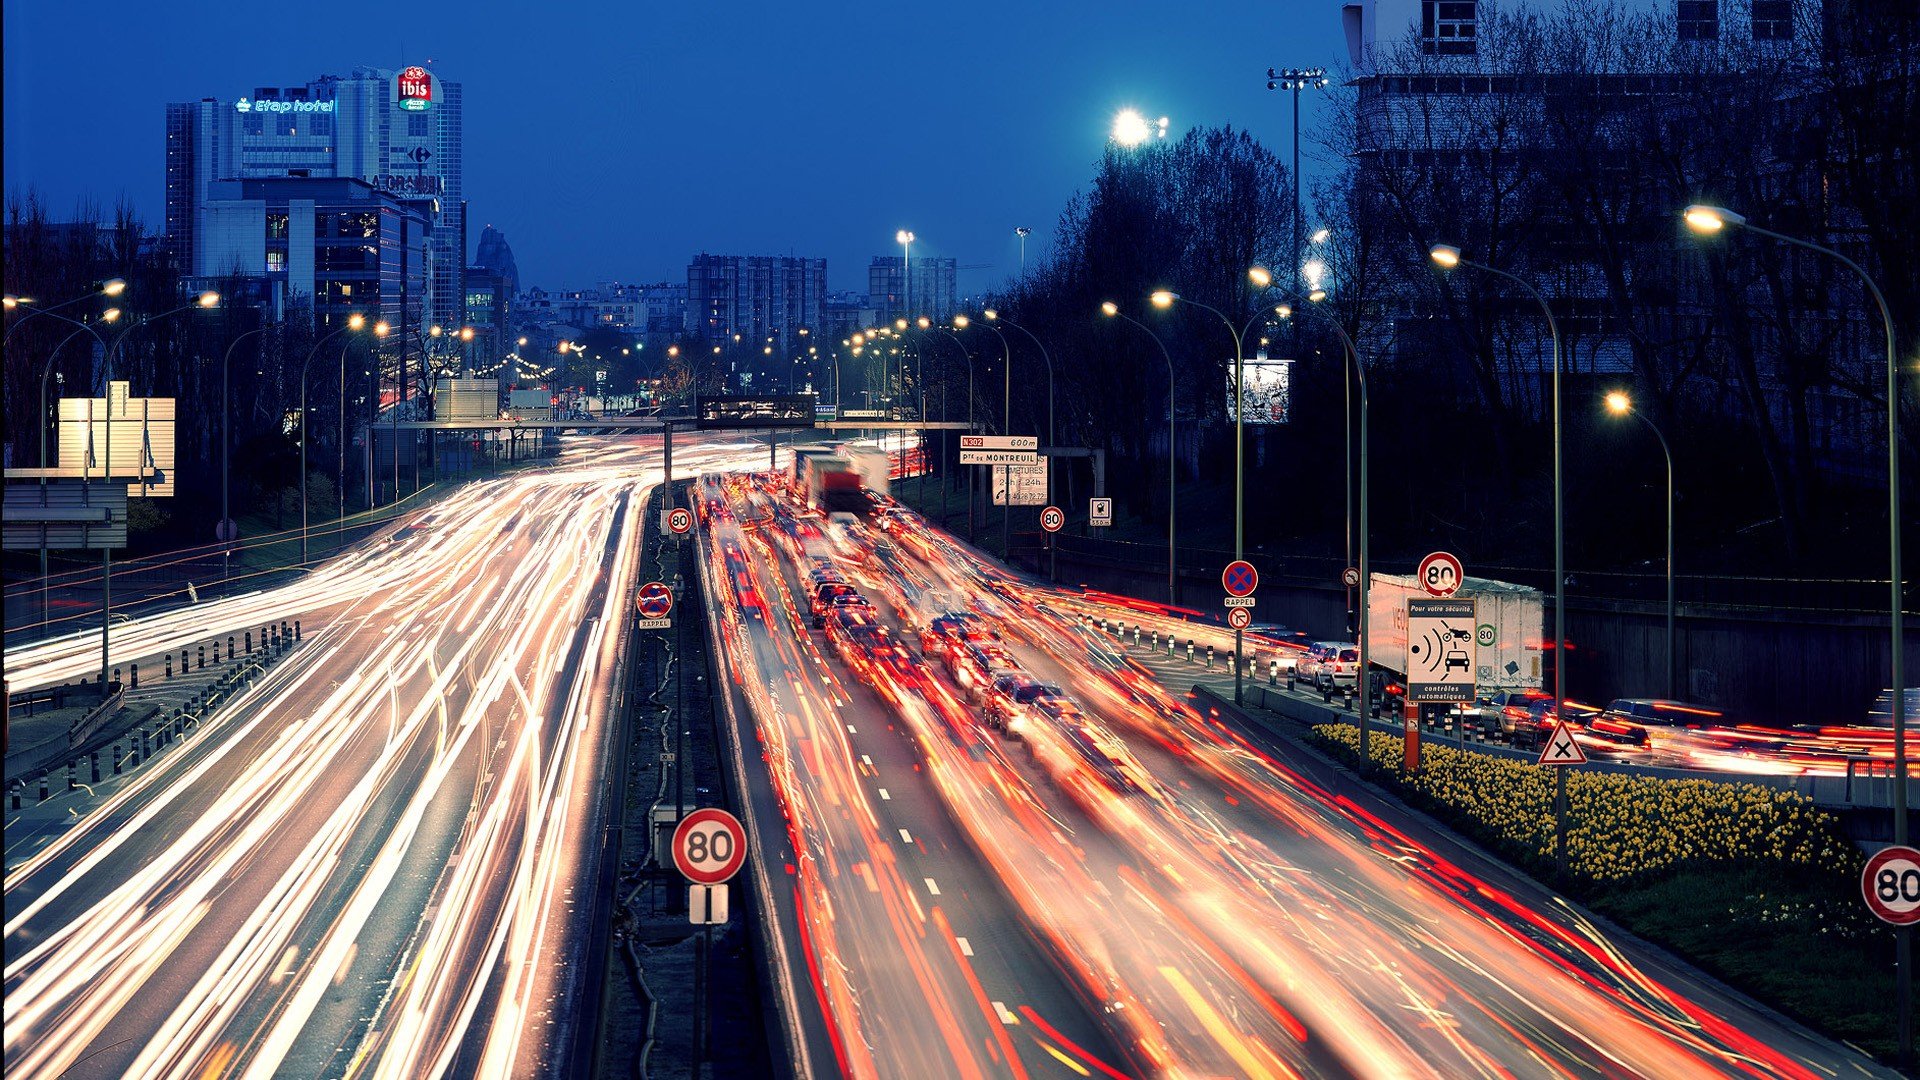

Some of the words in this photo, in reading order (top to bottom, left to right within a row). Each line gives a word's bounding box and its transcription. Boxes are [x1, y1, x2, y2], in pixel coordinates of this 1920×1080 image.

[402, 80, 427, 96] ibis
[255, 100, 292, 113] Etap
[293, 100, 334, 112] hotel
[963, 438, 983, 446] N302
[985, 454, 1035, 462] MONTREUIL
[996, 466, 1044, 475] FEMETURES
[672, 515, 688, 527] 80
[1045, 513, 1060, 525] 80
[1427, 566, 1453, 585] 80
[1479, 630, 1493, 640] 80
[1417, 693, 1466, 701] automatiques
[687, 830, 733, 864] 80
[1877, 868, 1920, 903] 80
